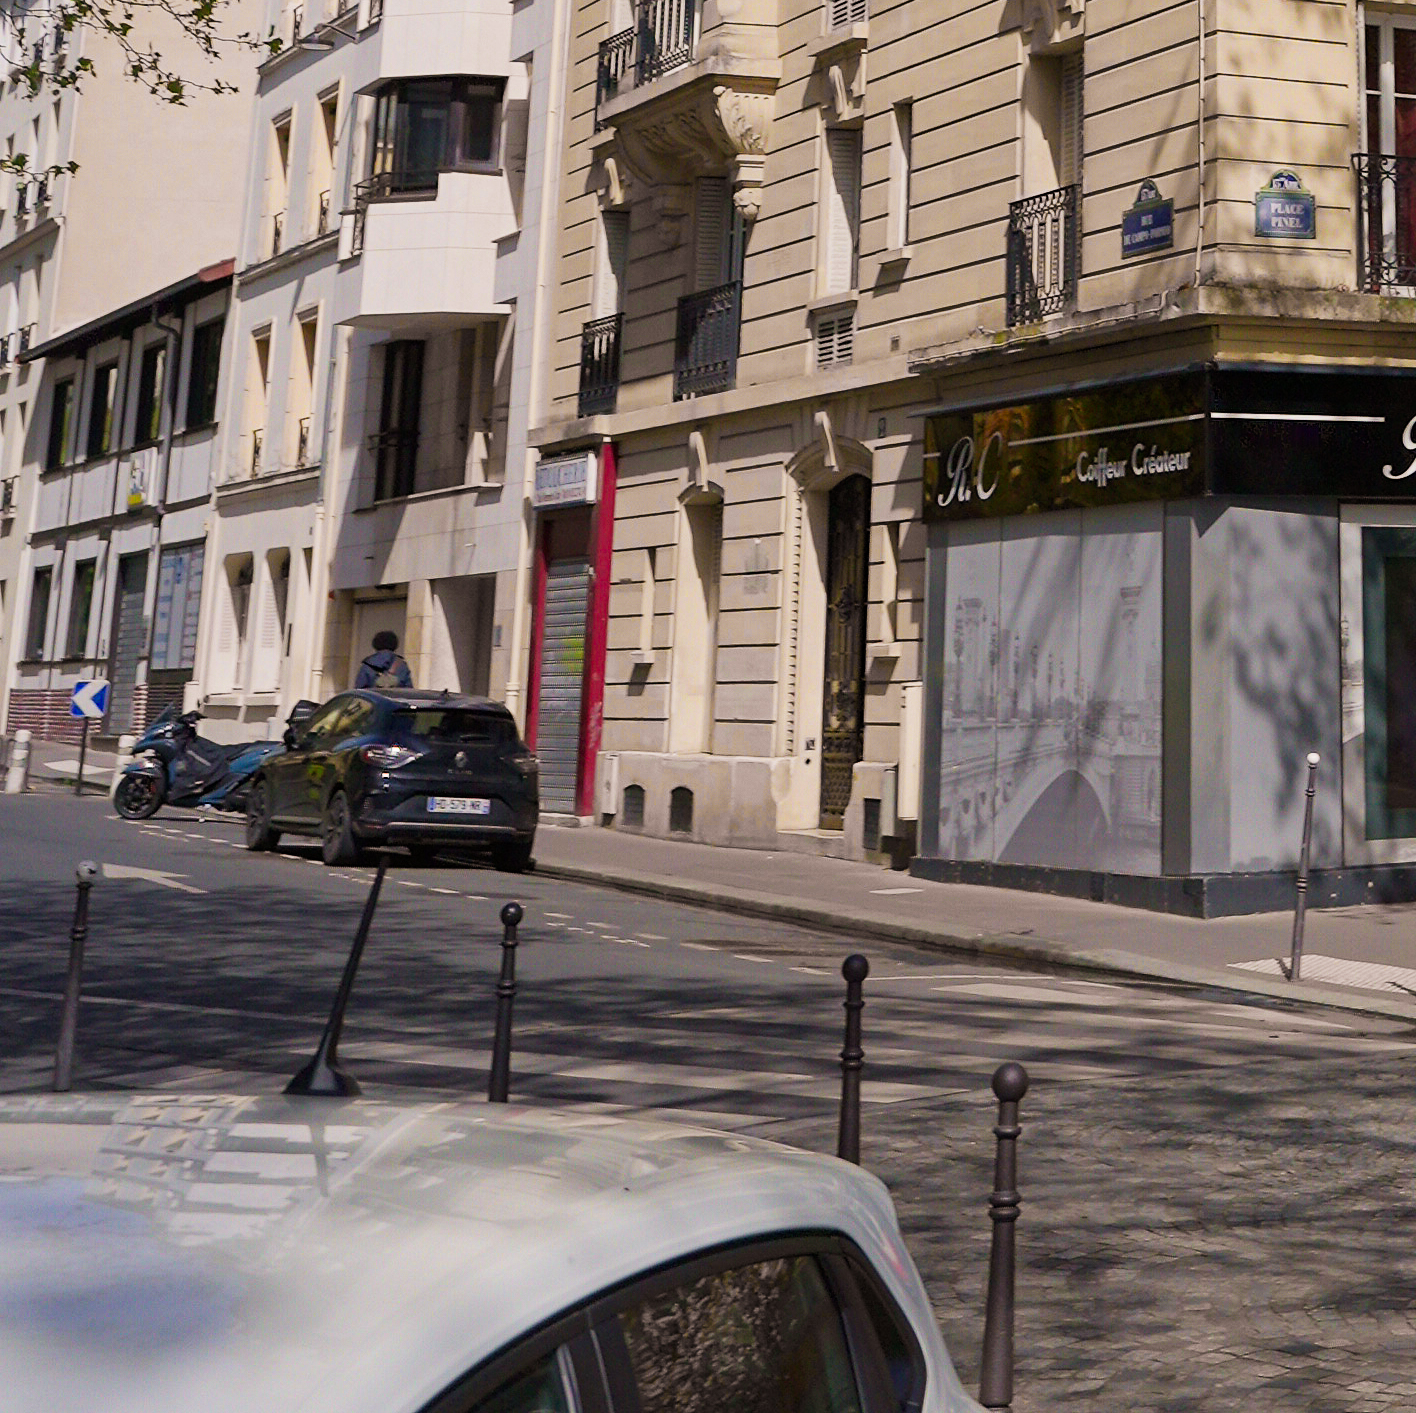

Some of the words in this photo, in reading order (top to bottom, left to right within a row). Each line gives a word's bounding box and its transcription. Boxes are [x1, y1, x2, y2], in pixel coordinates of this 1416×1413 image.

[1270, 202, 1305, 214] PLACE
[1271, 216, 1304, 228] PINEL
[1076, 447, 1128, 487] Coiffeur
[1131, 443, 1191, 476] Créateur
